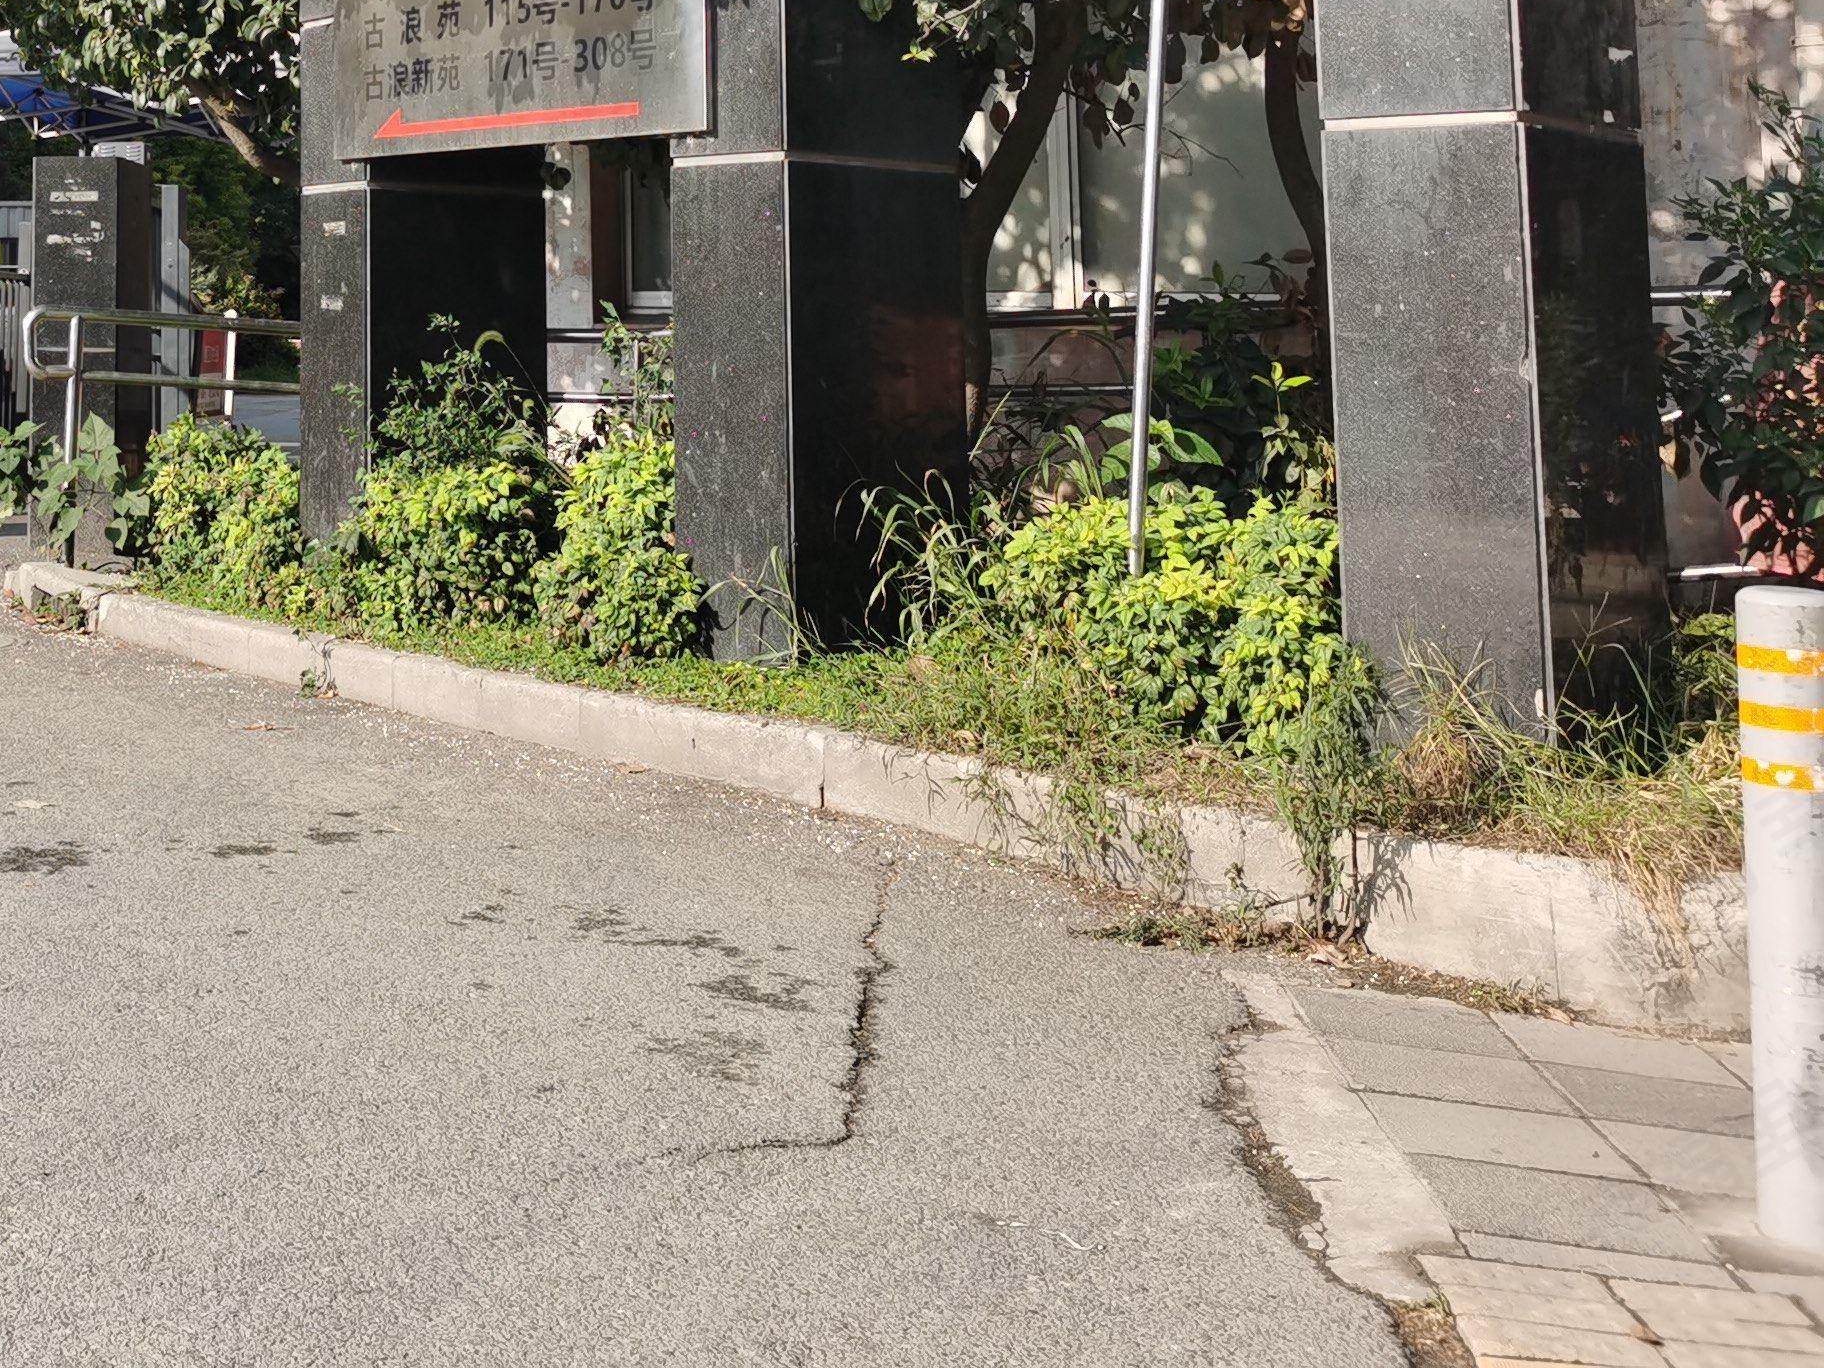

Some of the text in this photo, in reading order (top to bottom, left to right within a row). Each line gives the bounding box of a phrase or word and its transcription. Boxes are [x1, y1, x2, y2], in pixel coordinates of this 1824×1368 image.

[364, 0, 461, 50] 古浪苑
[364, 28, 657, 102] 古浪新苑 171号-308号
